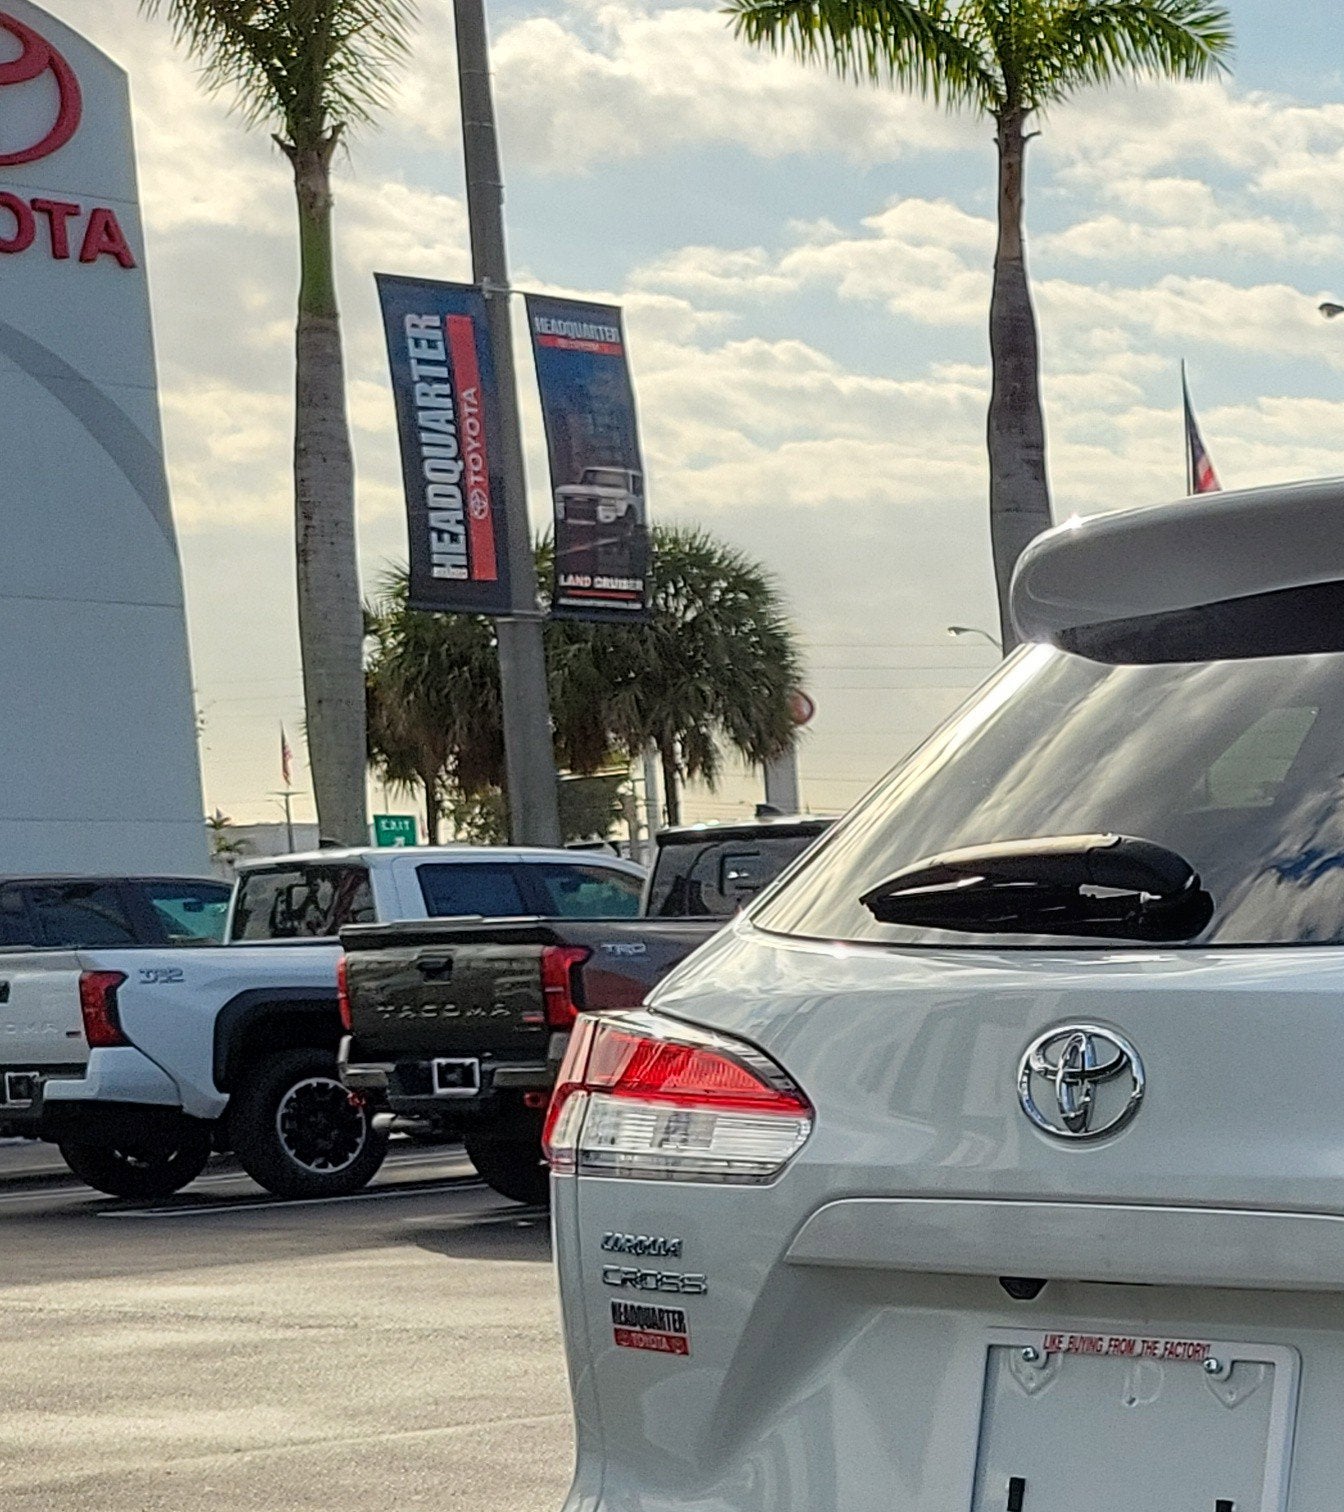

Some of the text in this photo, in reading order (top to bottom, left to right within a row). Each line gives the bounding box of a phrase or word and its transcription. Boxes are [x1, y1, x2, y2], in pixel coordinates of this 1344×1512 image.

[404, 313, 468, 580] HEADQUARTER
[460, 387, 486, 485] TOYOTA
[558, 574, 592, 588] LAND
[376, 1003, 512, 1020] TACOMA
[602, 1264, 708, 1295] CROSS
[611, 1301, 687, 1334] HEADQUARTER
[1043, 1334, 1063, 1351] LIKE
[1067, 1335, 1104, 1353] BUYING
[1108, 1337, 1136, 1355] FROM
[1141, 1339, 1159, 1357] THE
